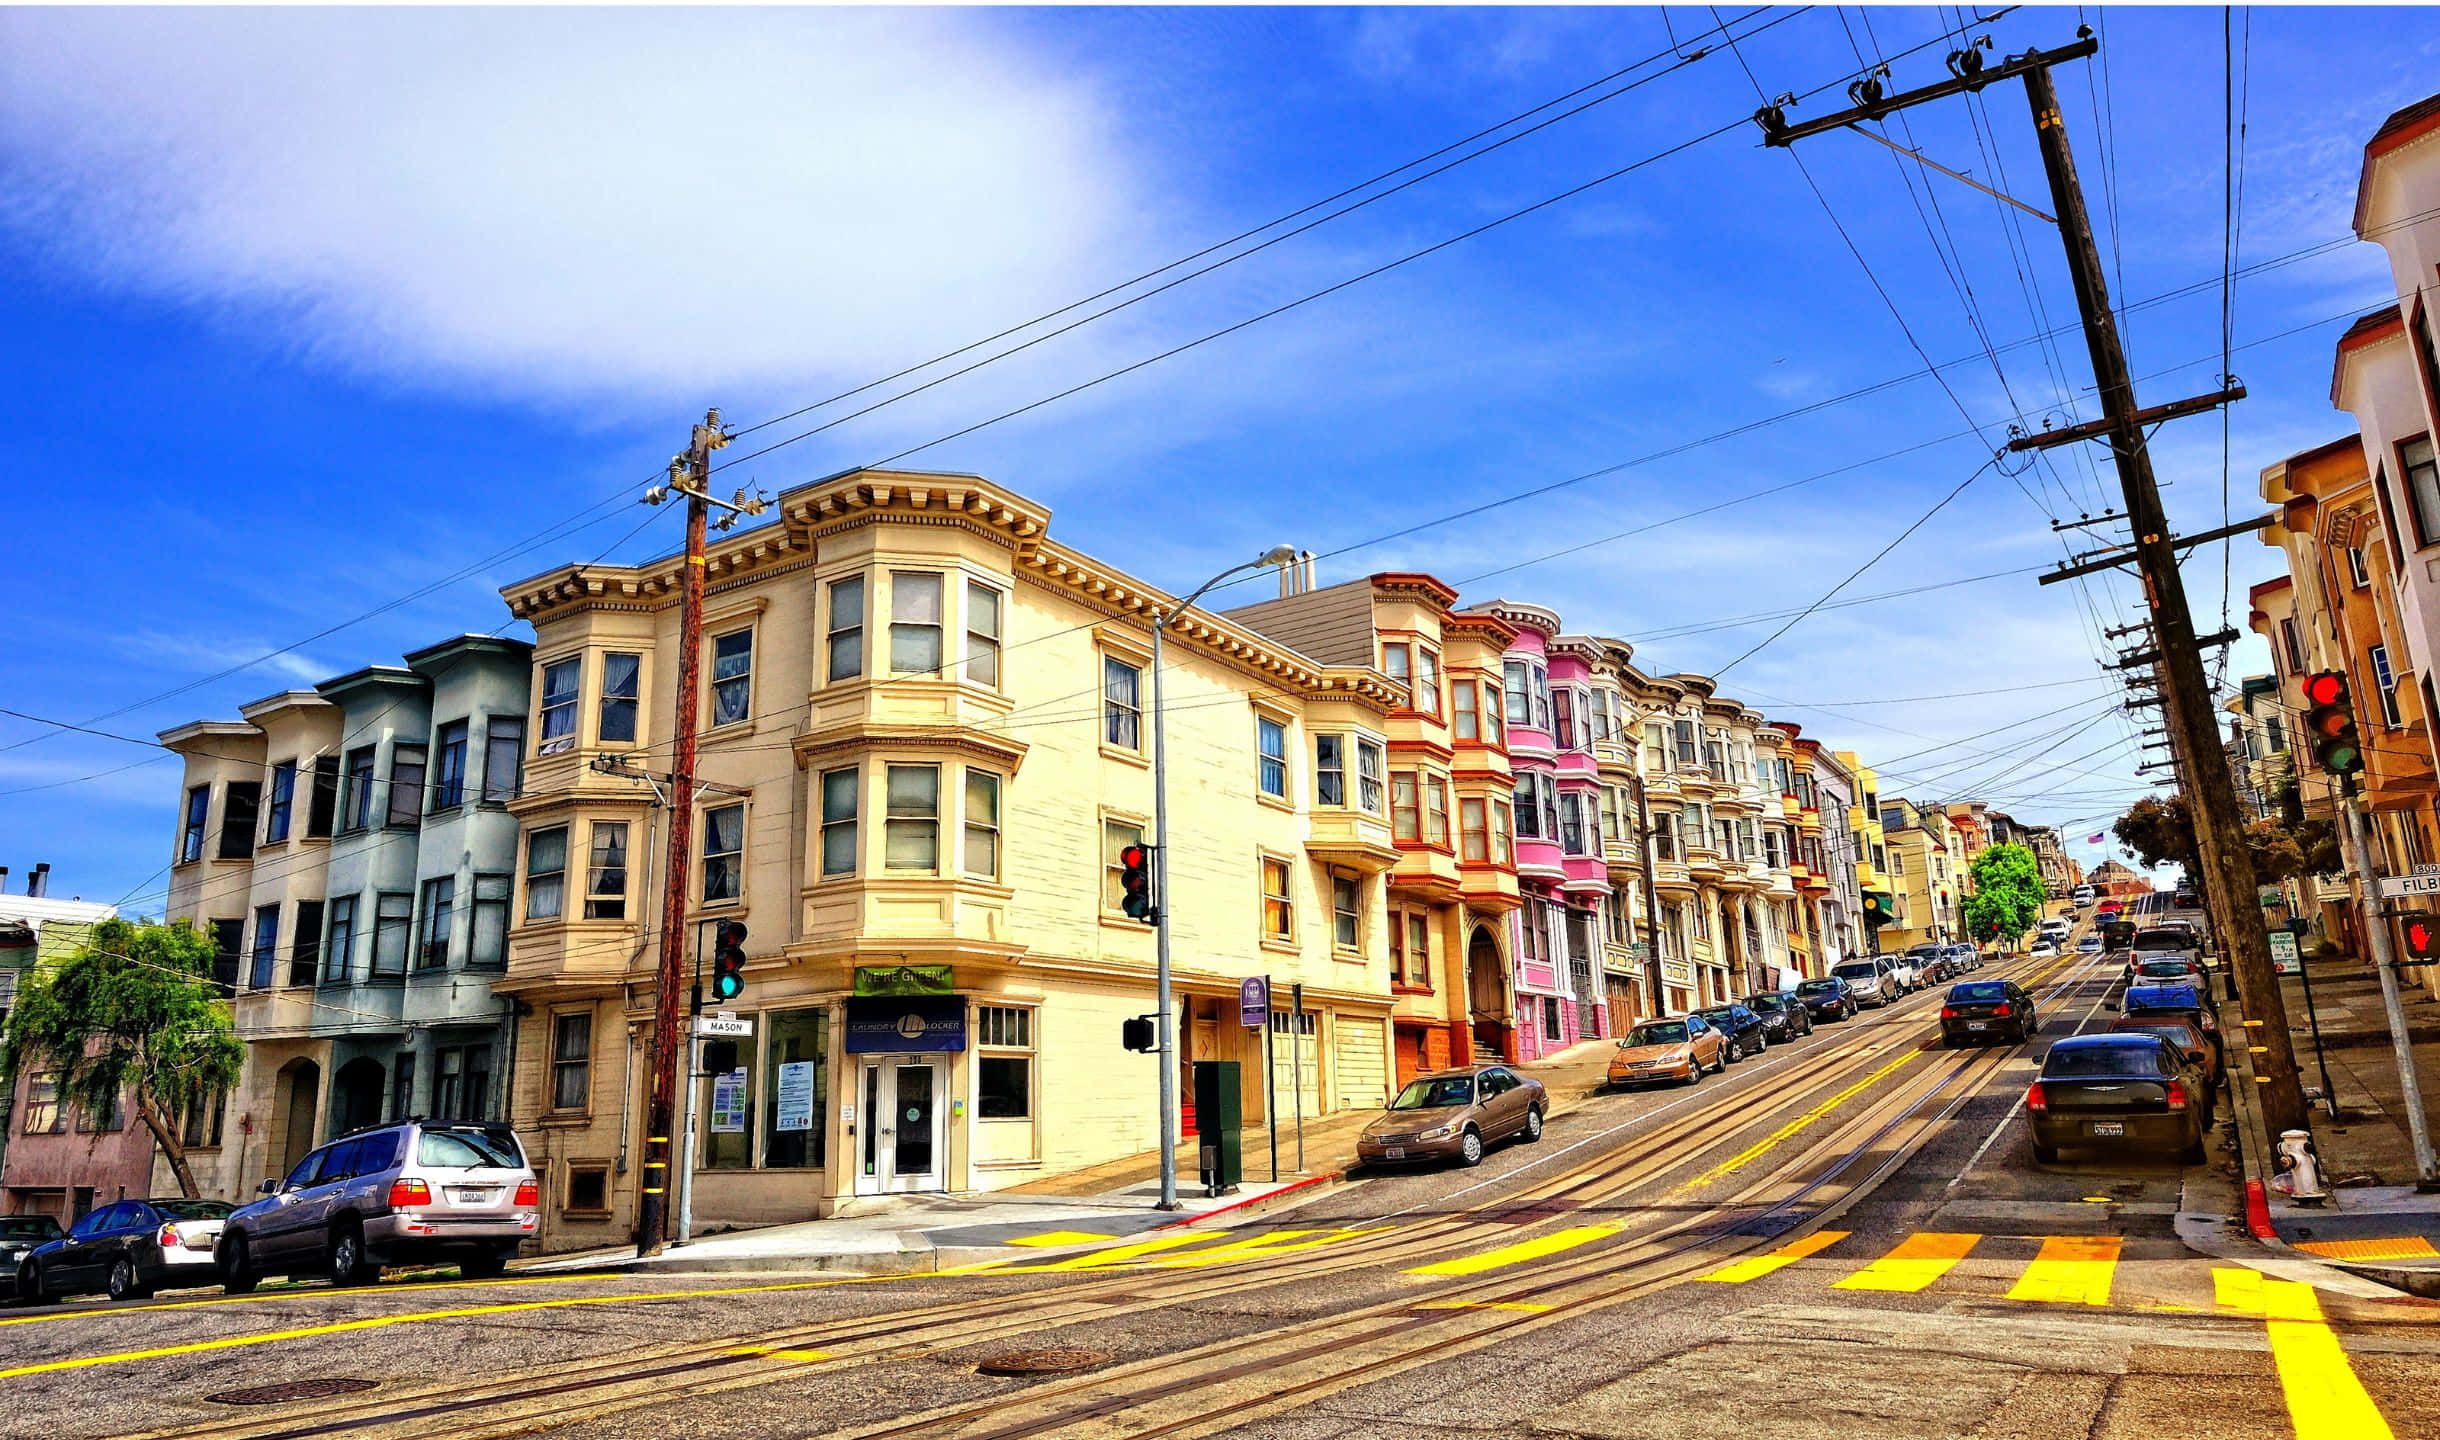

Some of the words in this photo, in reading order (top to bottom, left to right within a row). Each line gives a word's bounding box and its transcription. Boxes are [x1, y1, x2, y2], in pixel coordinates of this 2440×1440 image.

[2403, 878, 2440, 891] FILB
[862, 971, 897, 982] WE'RE
[710, 1022, 743, 1031] MASON
[852, 1023, 896, 1031] LAUNDRY
[927, 1022, 960, 1030] LOCKER
